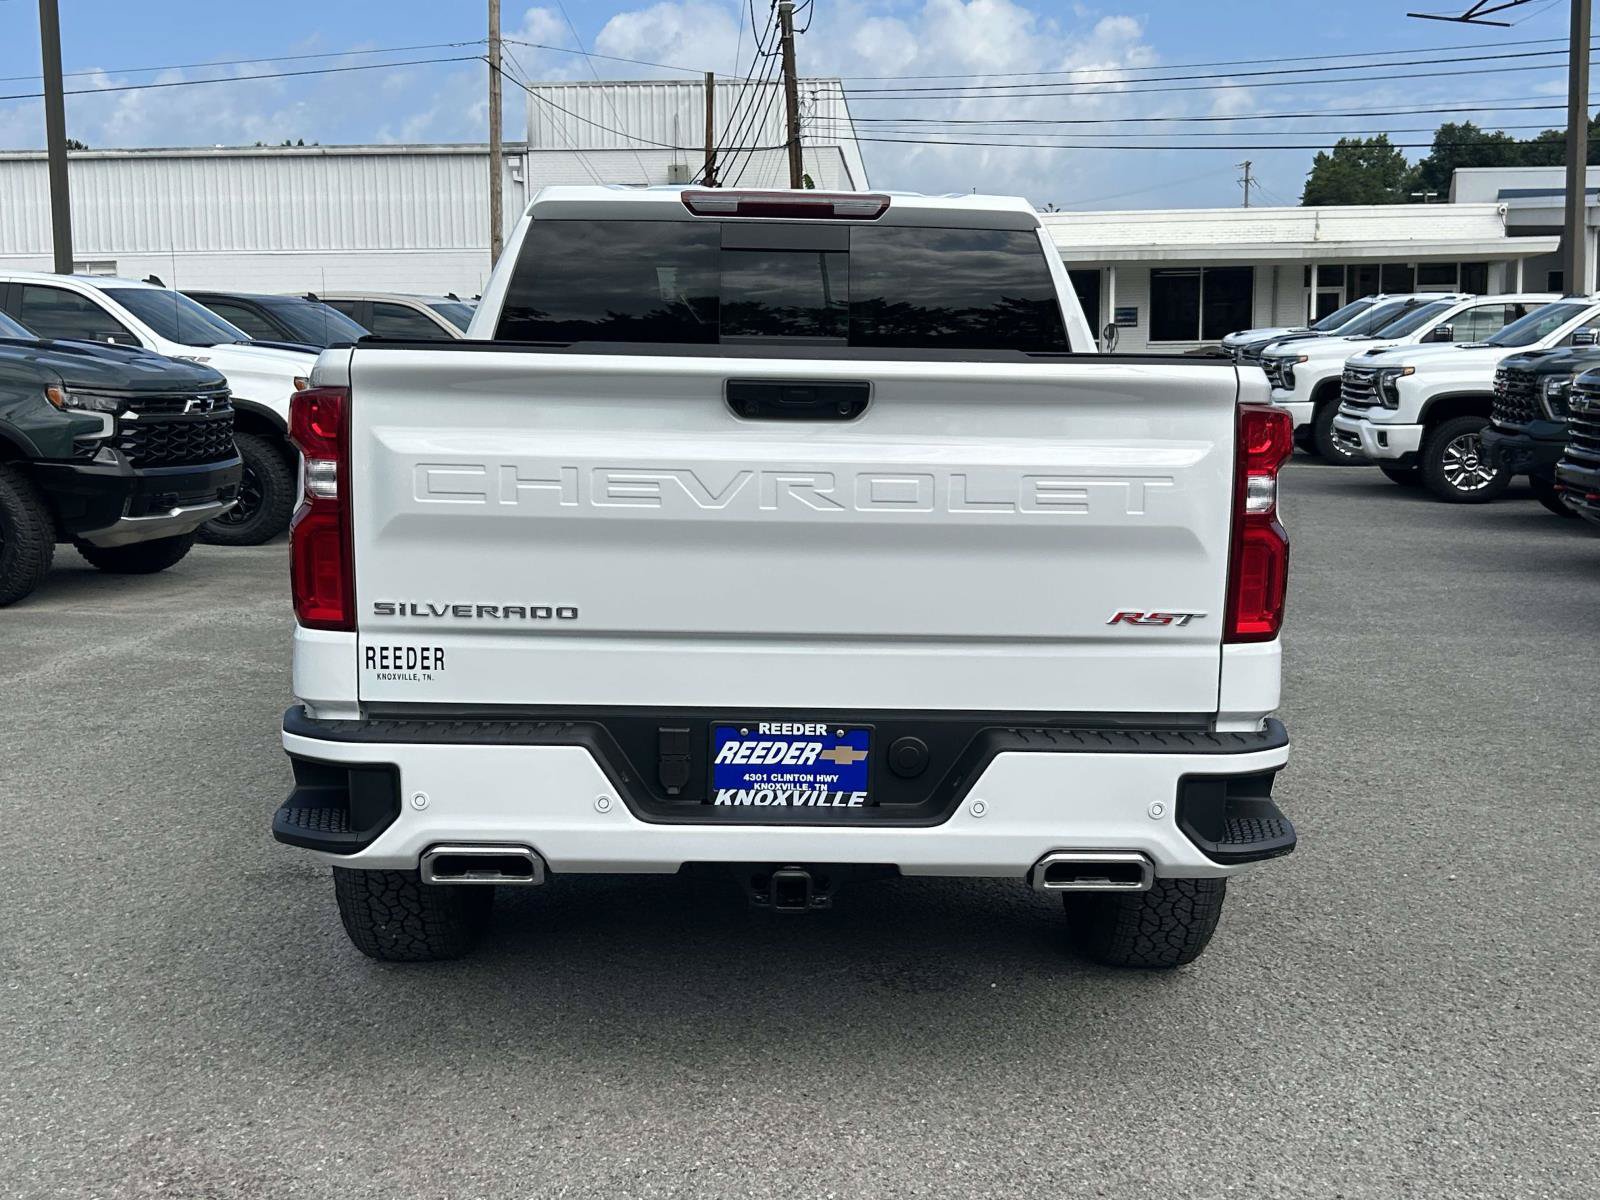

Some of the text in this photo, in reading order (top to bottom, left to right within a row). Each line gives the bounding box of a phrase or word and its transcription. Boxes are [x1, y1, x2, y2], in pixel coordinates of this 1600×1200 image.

[413, 463, 1175, 515] CHEVROLET
[374, 602, 578, 620] SILVERADO
[1106, 611, 1208, 627] RST
[365, 646, 445, 671] REEDER
[376, 673, 435, 682] KNOXVILLE, TN.
[758, 722, 828, 736] REEDER
[714, 741, 823, 766] REEDER
[743, 773, 839, 783] 4301 CLINTON HWY
[714, 788, 868, 808] KNOXVILLE
